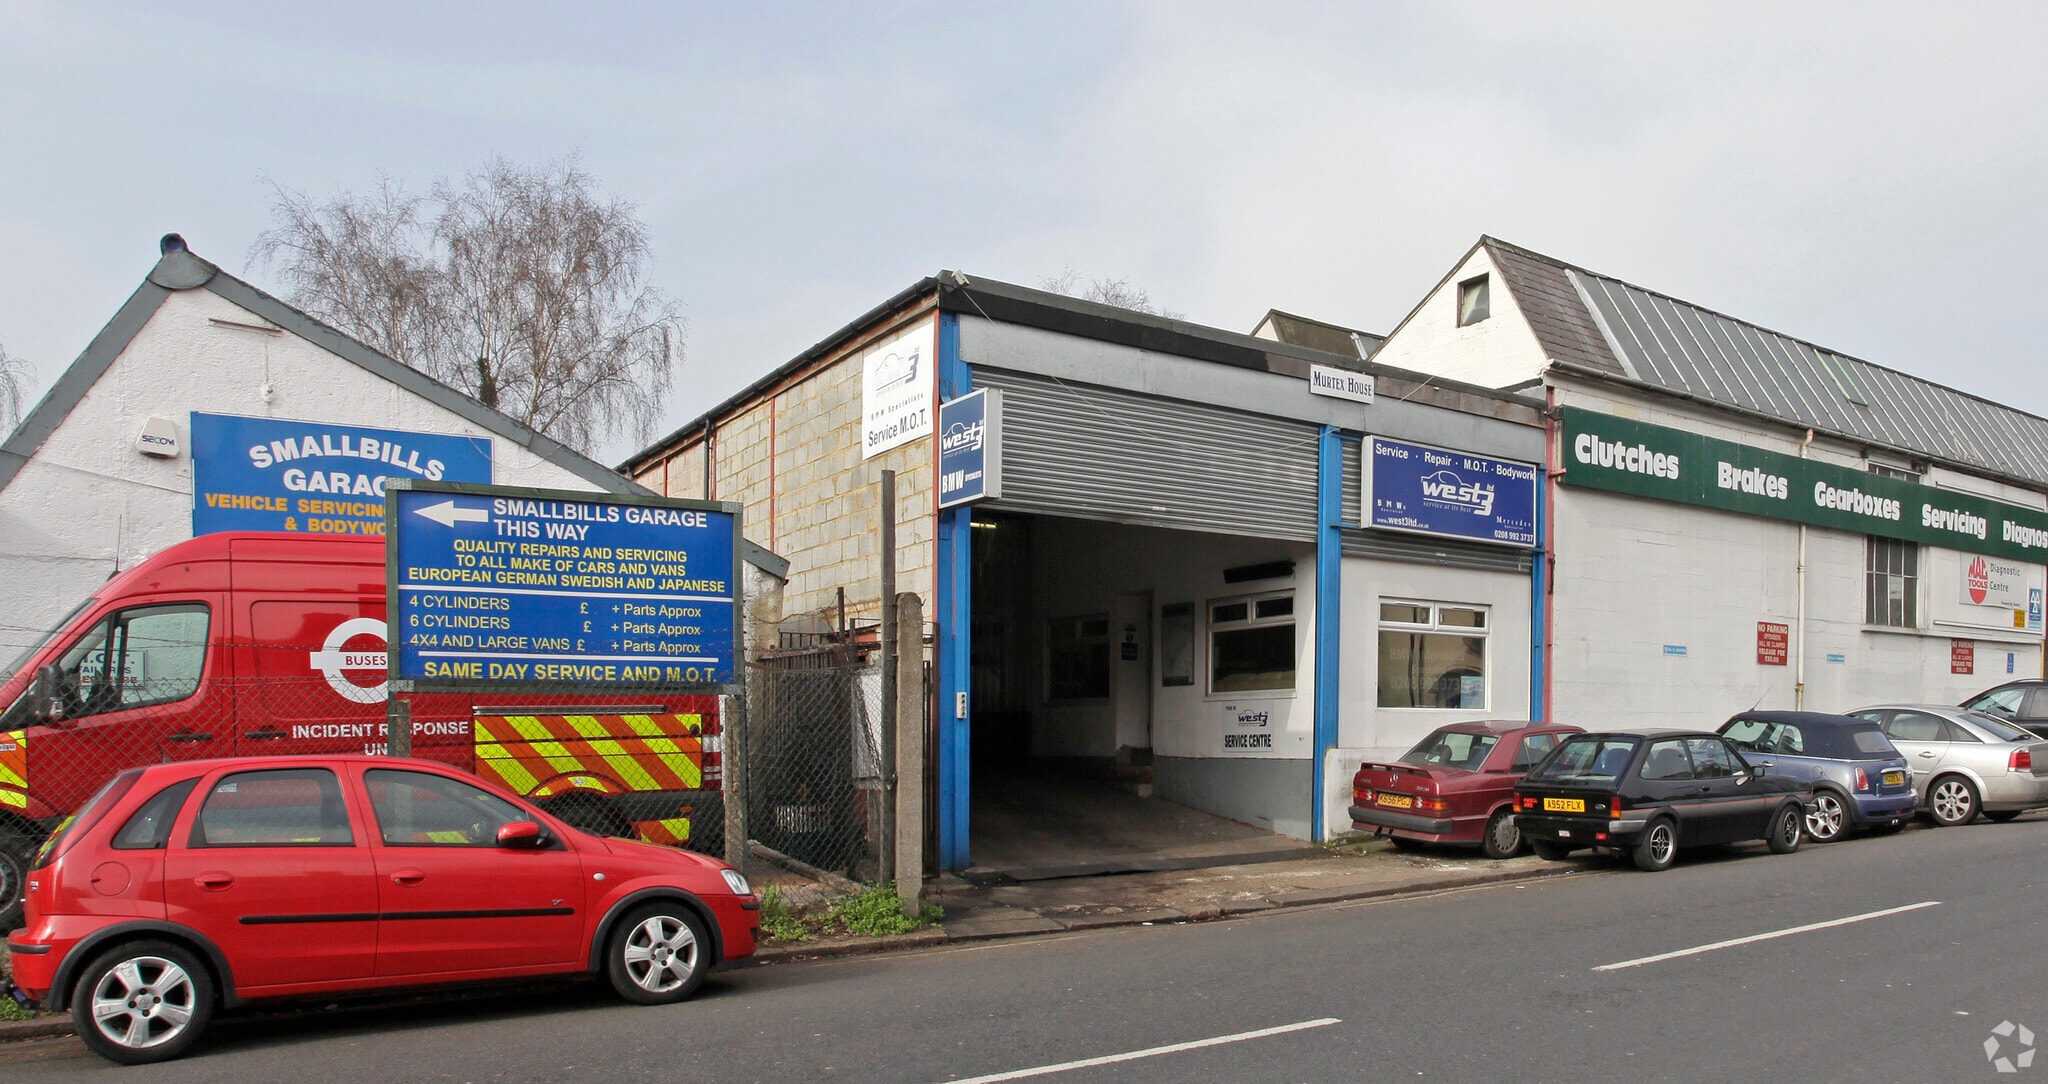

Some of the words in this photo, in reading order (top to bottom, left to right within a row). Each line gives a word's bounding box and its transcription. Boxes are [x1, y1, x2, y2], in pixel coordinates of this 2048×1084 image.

[868, 424, 898, 447] Service
[899, 408, 927, 434] M.O.T.
[141, 433, 176, 447] SECOM
[249, 434, 446, 481] SMALLBILLS
[1376, 443, 1409, 459] Service
[1424, 451, 1452, 467] Repair
[1463, 458, 1489, 474] M.O.T.
[1496, 464, 1535, 480] Bodywork
[942, 470, 964, 494] BMW
[1574, 432, 1680, 481] Clutches
[1717, 461, 1789, 500] Brakes
[1813, 480, 1901, 522] Gearboxes
[1921, 503, 1987, 541] Servicing
[205, 492, 288, 512] VEHICLE
[298, 499, 386, 518] SERVICIN
[1422, 481, 1495, 516] west3
[284, 517, 298, 531] &
[493, 498, 620, 523] SMALLBILLS
[625, 508, 707, 528] GARAGE
[1496, 516, 1531, 528] Mercedes
[493, 519, 541, 538] THIS
[545, 522, 589, 541] WAY
[1494, 530, 1508, 539] 0208
[1509, 532, 1520, 541] 992
[1520, 533, 1534, 542] 3737
[453, 539, 517, 556] QUALITY
[520, 543, 579, 559] REPAIRS
[583, 546, 612, 560] AND
[615, 548, 687, 563] SERVICING
[456, 554, 476, 567] TO
[479, 555, 507, 569] ALL
[510, 557, 552, 571] MAKE
[555, 559, 573, 573] OF
[577, 560, 616, 574] CARS
[618, 563, 647, 575] AND
[650, 564, 687, 577] VANS
[1968, 556, 1988, 580] MAC
[1990, 563, 2021, 577] Diagnostic
[409, 567, 493, 583] EUROPEAN
[495, 571, 558, 586] GERMAN
[560, 574, 623, 589] SWEDISH
[626, 577, 655, 590] AND
[658, 579, 726, 592] JAPANESE
[1967, 579, 1988, 589] TOOLS
[1989, 581, 2009, 592] Centre
[410, 596, 418, 607] 4
[423, 595, 510, 611] CYLINDERS
[580, 602, 588, 614] £
[623, 603, 656, 617] Parts
[658, 605, 702, 619] Approx
[410, 615, 418, 627] 6
[423, 615, 510, 630] CYLINDERS
[583, 621, 592, 633] £
[623, 621, 656, 634] Parts
[658, 622, 701, 637] Approx
[1758, 624, 1766, 632] NO
[1766, 625, 1788, 634] PARKING
[410, 634, 439, 646] 4X4
[442, 634, 475, 647] AND
[478, 636, 528, 650] LARGE
[531, 637, 570, 650] VANS
[576, 639, 585, 651] £
[623, 639, 656, 652] Parts
[658, 640, 701, 655] Approx
[345, 655, 386, 666] BUSES
[424, 662, 483, 679] SAME
[489, 663, 528, 680] DAY
[534, 664, 617, 682] SERVICE
[621, 665, 661, 682] AND
[666, 666, 718, 683] M.O.T.
[293, 723, 374, 739] INCIDENT
[379, 721, 469, 737] RPONSE
[1224, 734, 1248, 748] SERVICE
[1248, 734, 1272, 748] CENTRE
[1567, 800, 1582, 810] FLX
